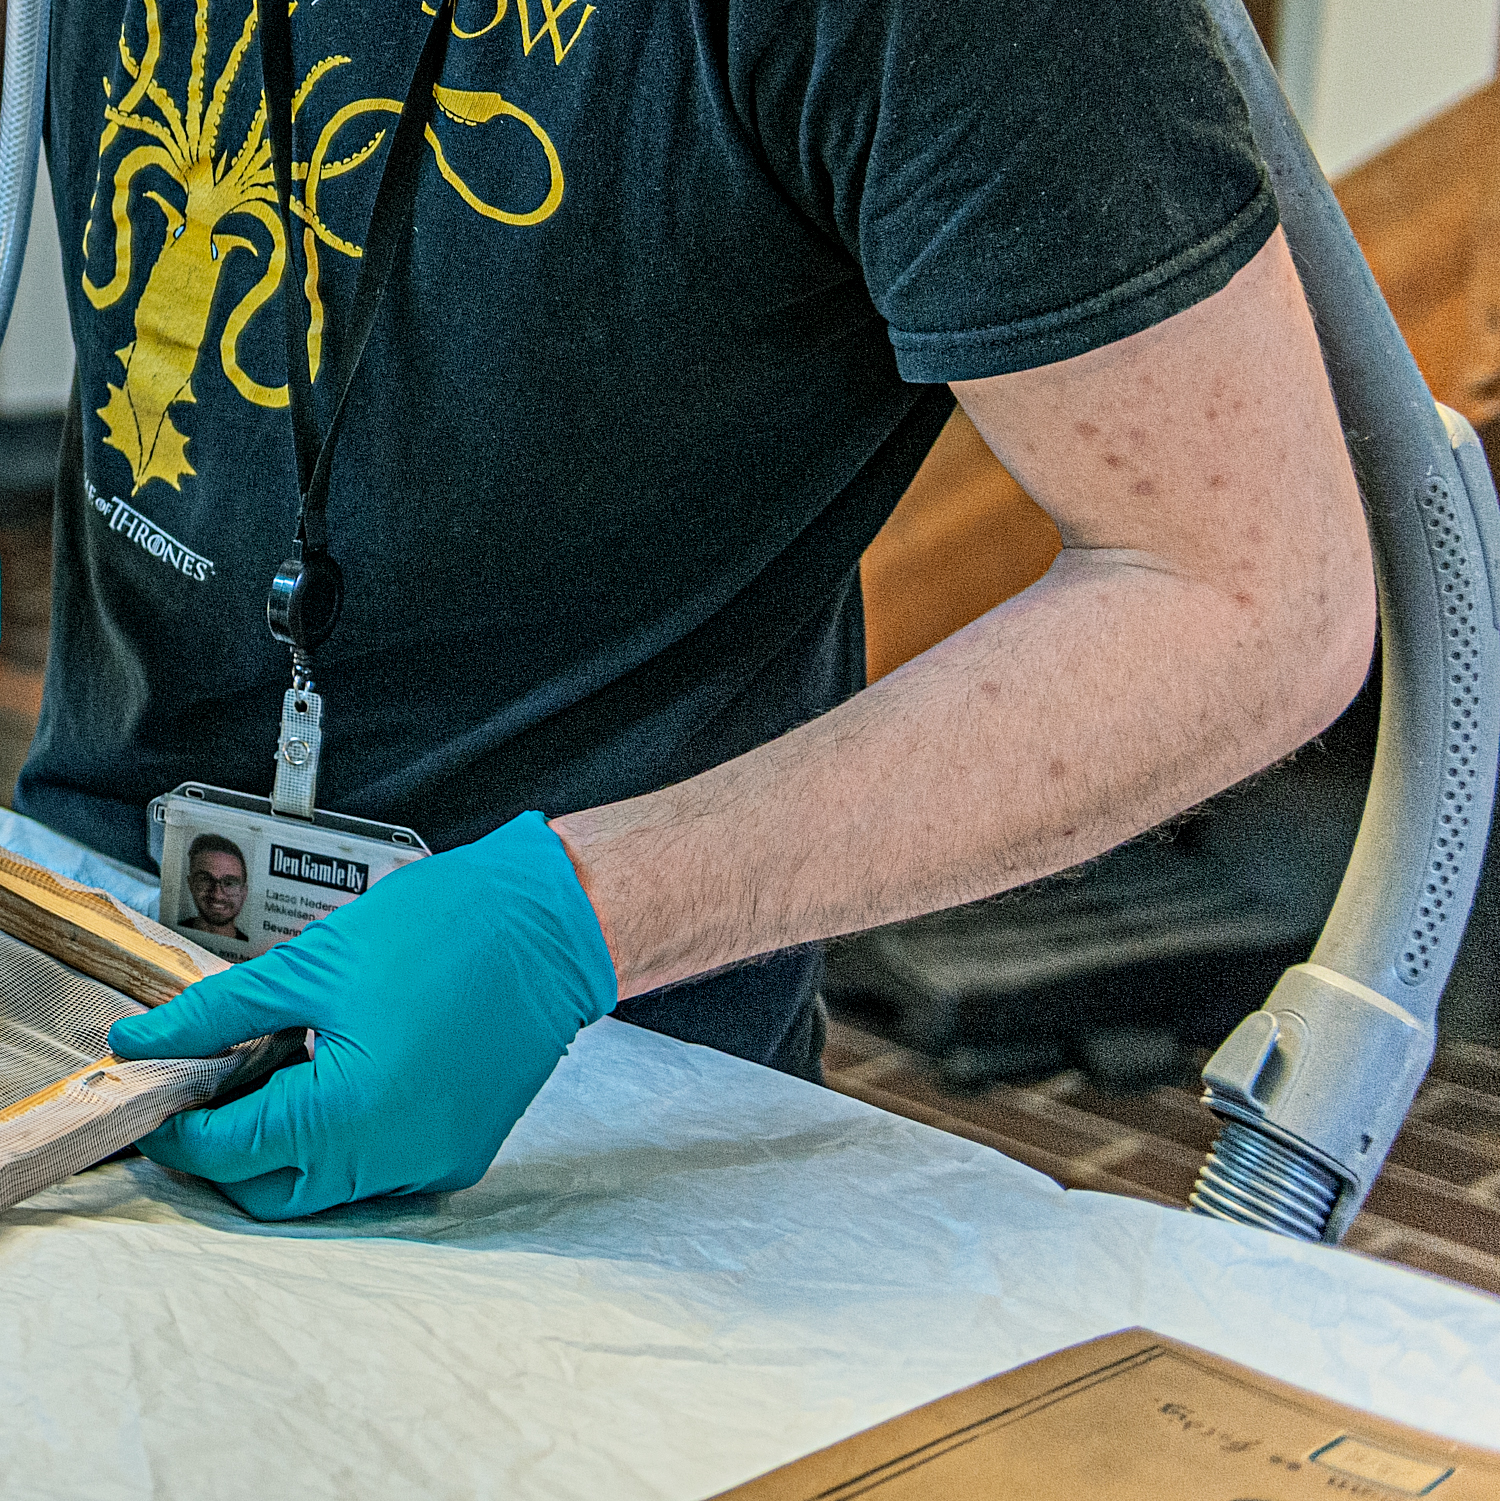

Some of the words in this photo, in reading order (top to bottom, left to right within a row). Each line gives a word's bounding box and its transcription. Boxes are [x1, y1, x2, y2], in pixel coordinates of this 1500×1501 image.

[108, 496, 214, 582] THRONES
[272, 847, 299, 877] Den
[300, 853, 345, 887] Gamle
[345, 863, 366, 893] By
